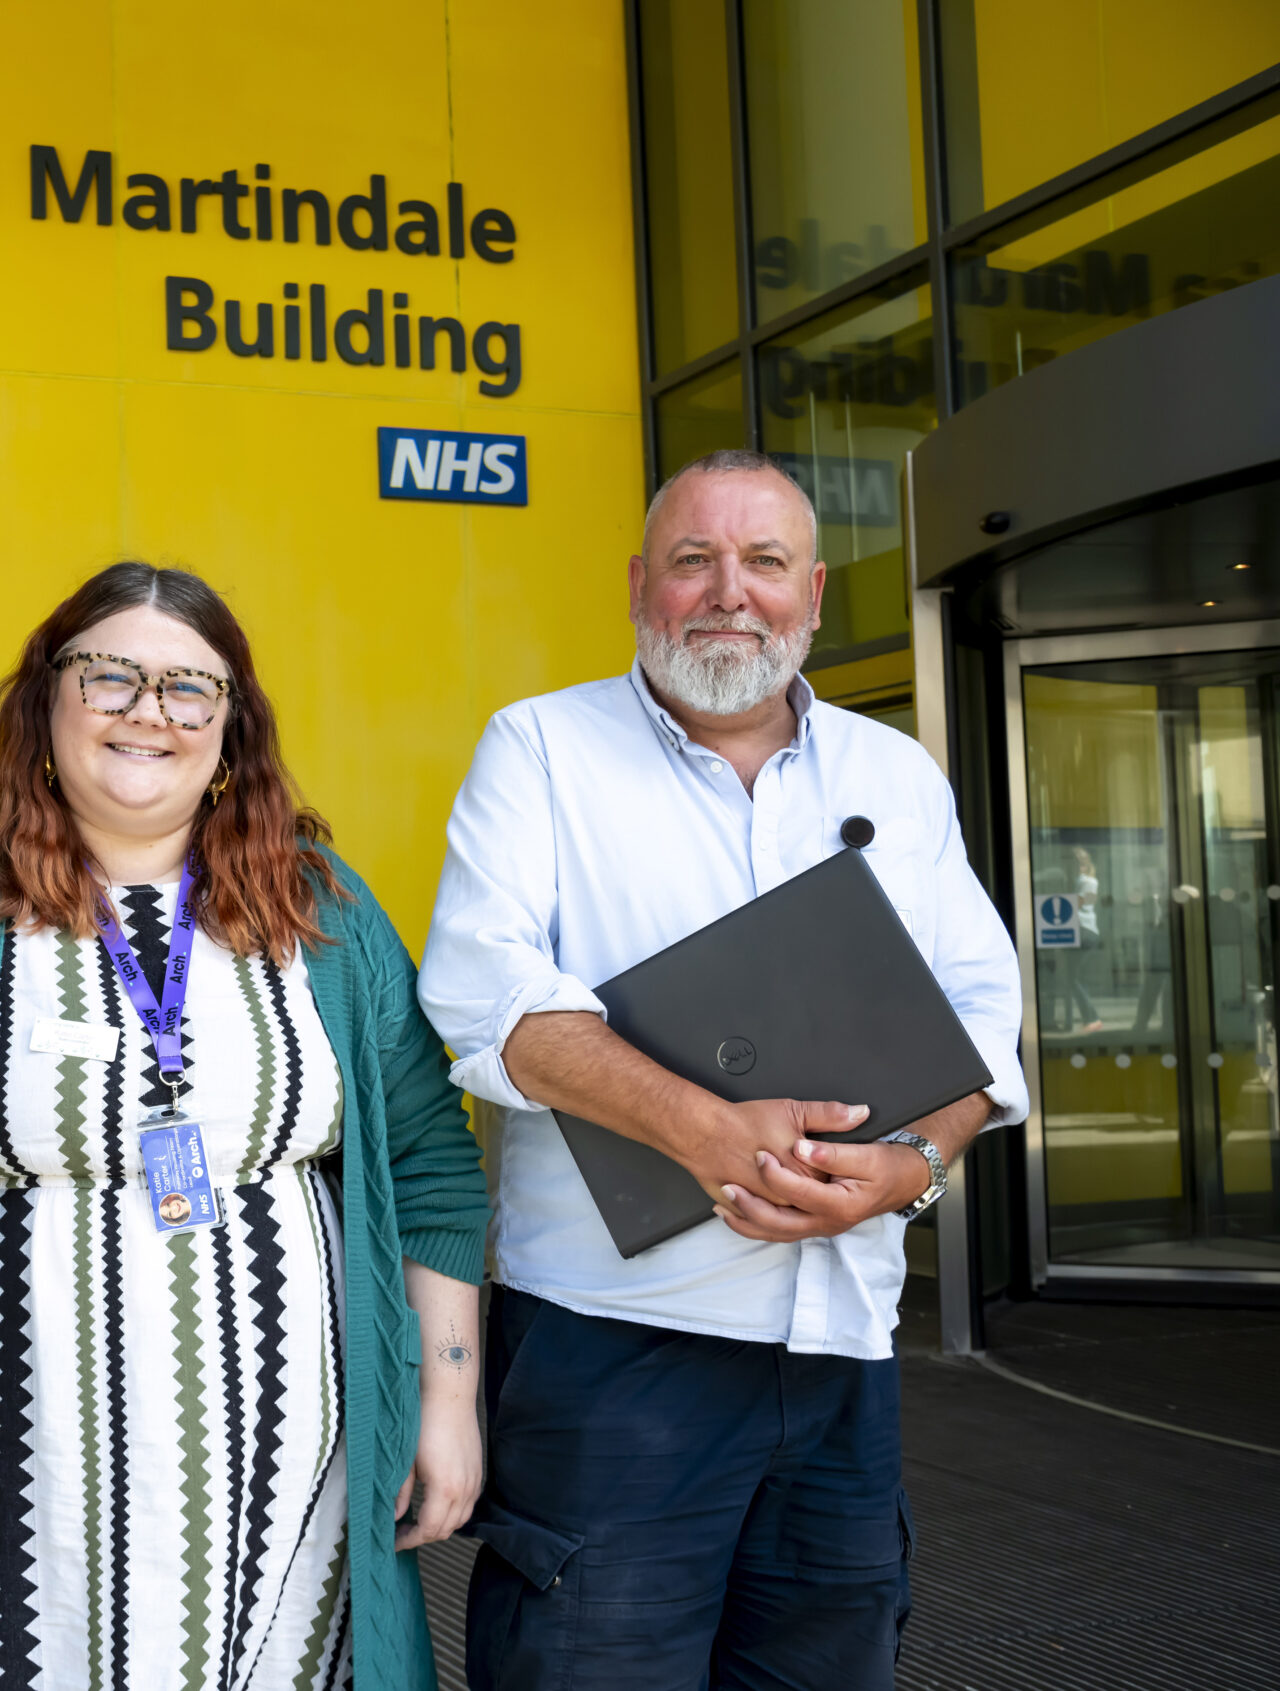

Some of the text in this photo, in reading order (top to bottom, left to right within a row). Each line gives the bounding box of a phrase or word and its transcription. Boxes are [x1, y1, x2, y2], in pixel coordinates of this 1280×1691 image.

[30, 144, 516, 263] Martindale
[165, 276, 520, 397] Building
[389, 437, 517, 494] NHS
[153, 1172, 162, 1194] Katie
[162, 1165, 171, 1192] Carter
[199, 1194, 210, 1214] NHS
